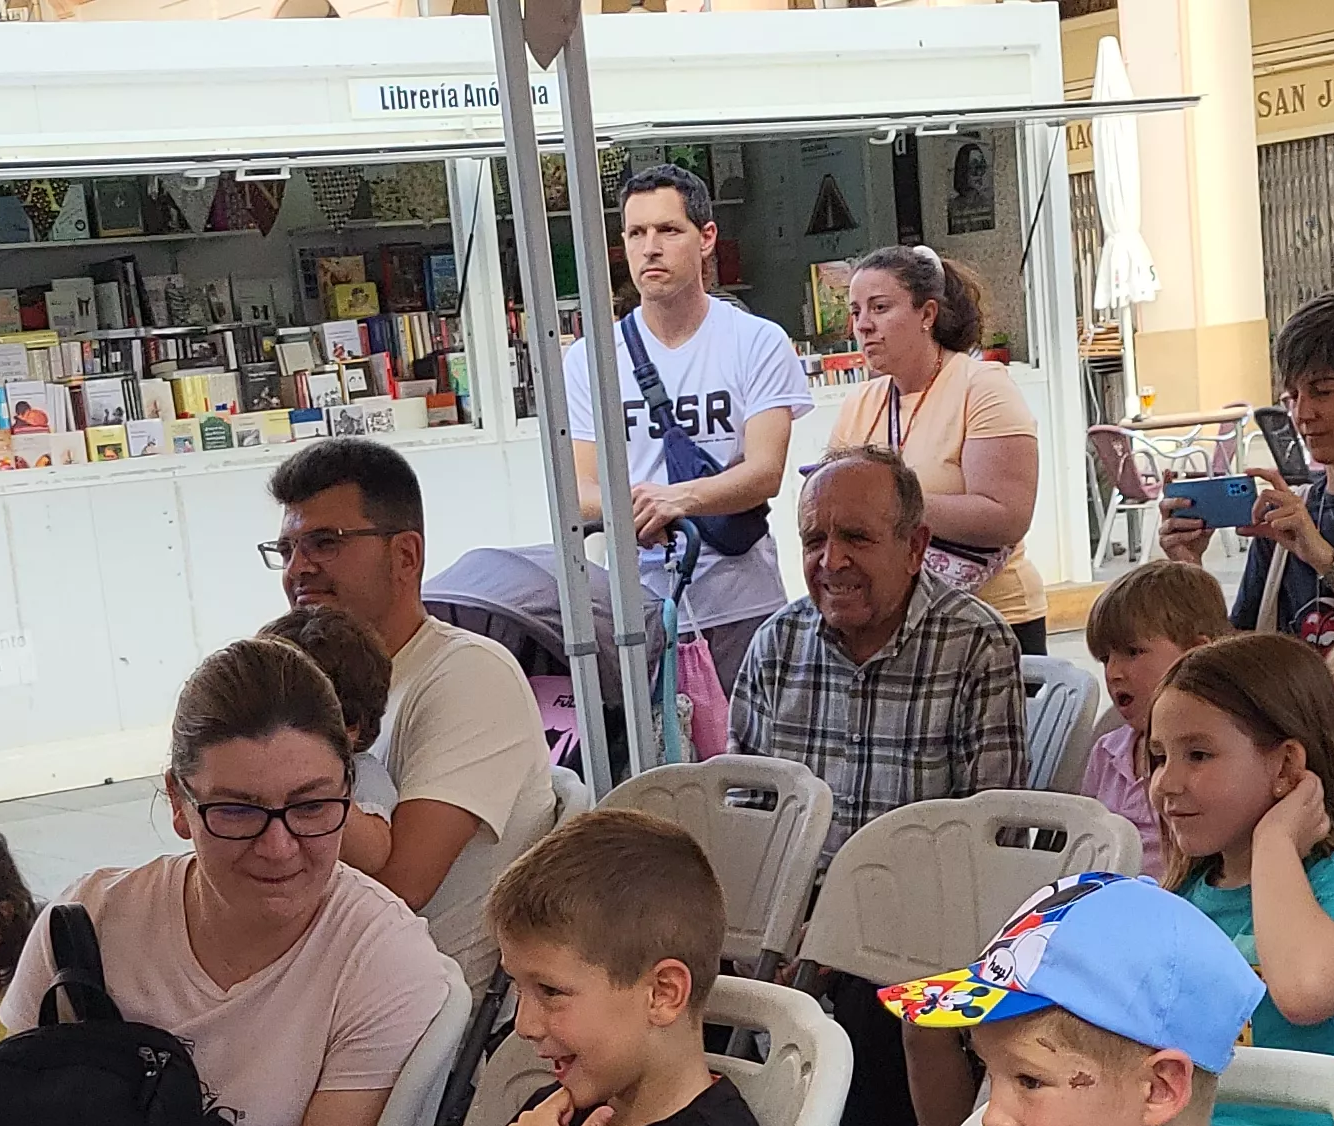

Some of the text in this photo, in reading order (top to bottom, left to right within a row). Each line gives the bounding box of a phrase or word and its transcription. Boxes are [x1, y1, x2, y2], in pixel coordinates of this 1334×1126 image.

[379, 81, 549, 110] Librería Anóa
[1257, 83, 1307, 118] SAN
